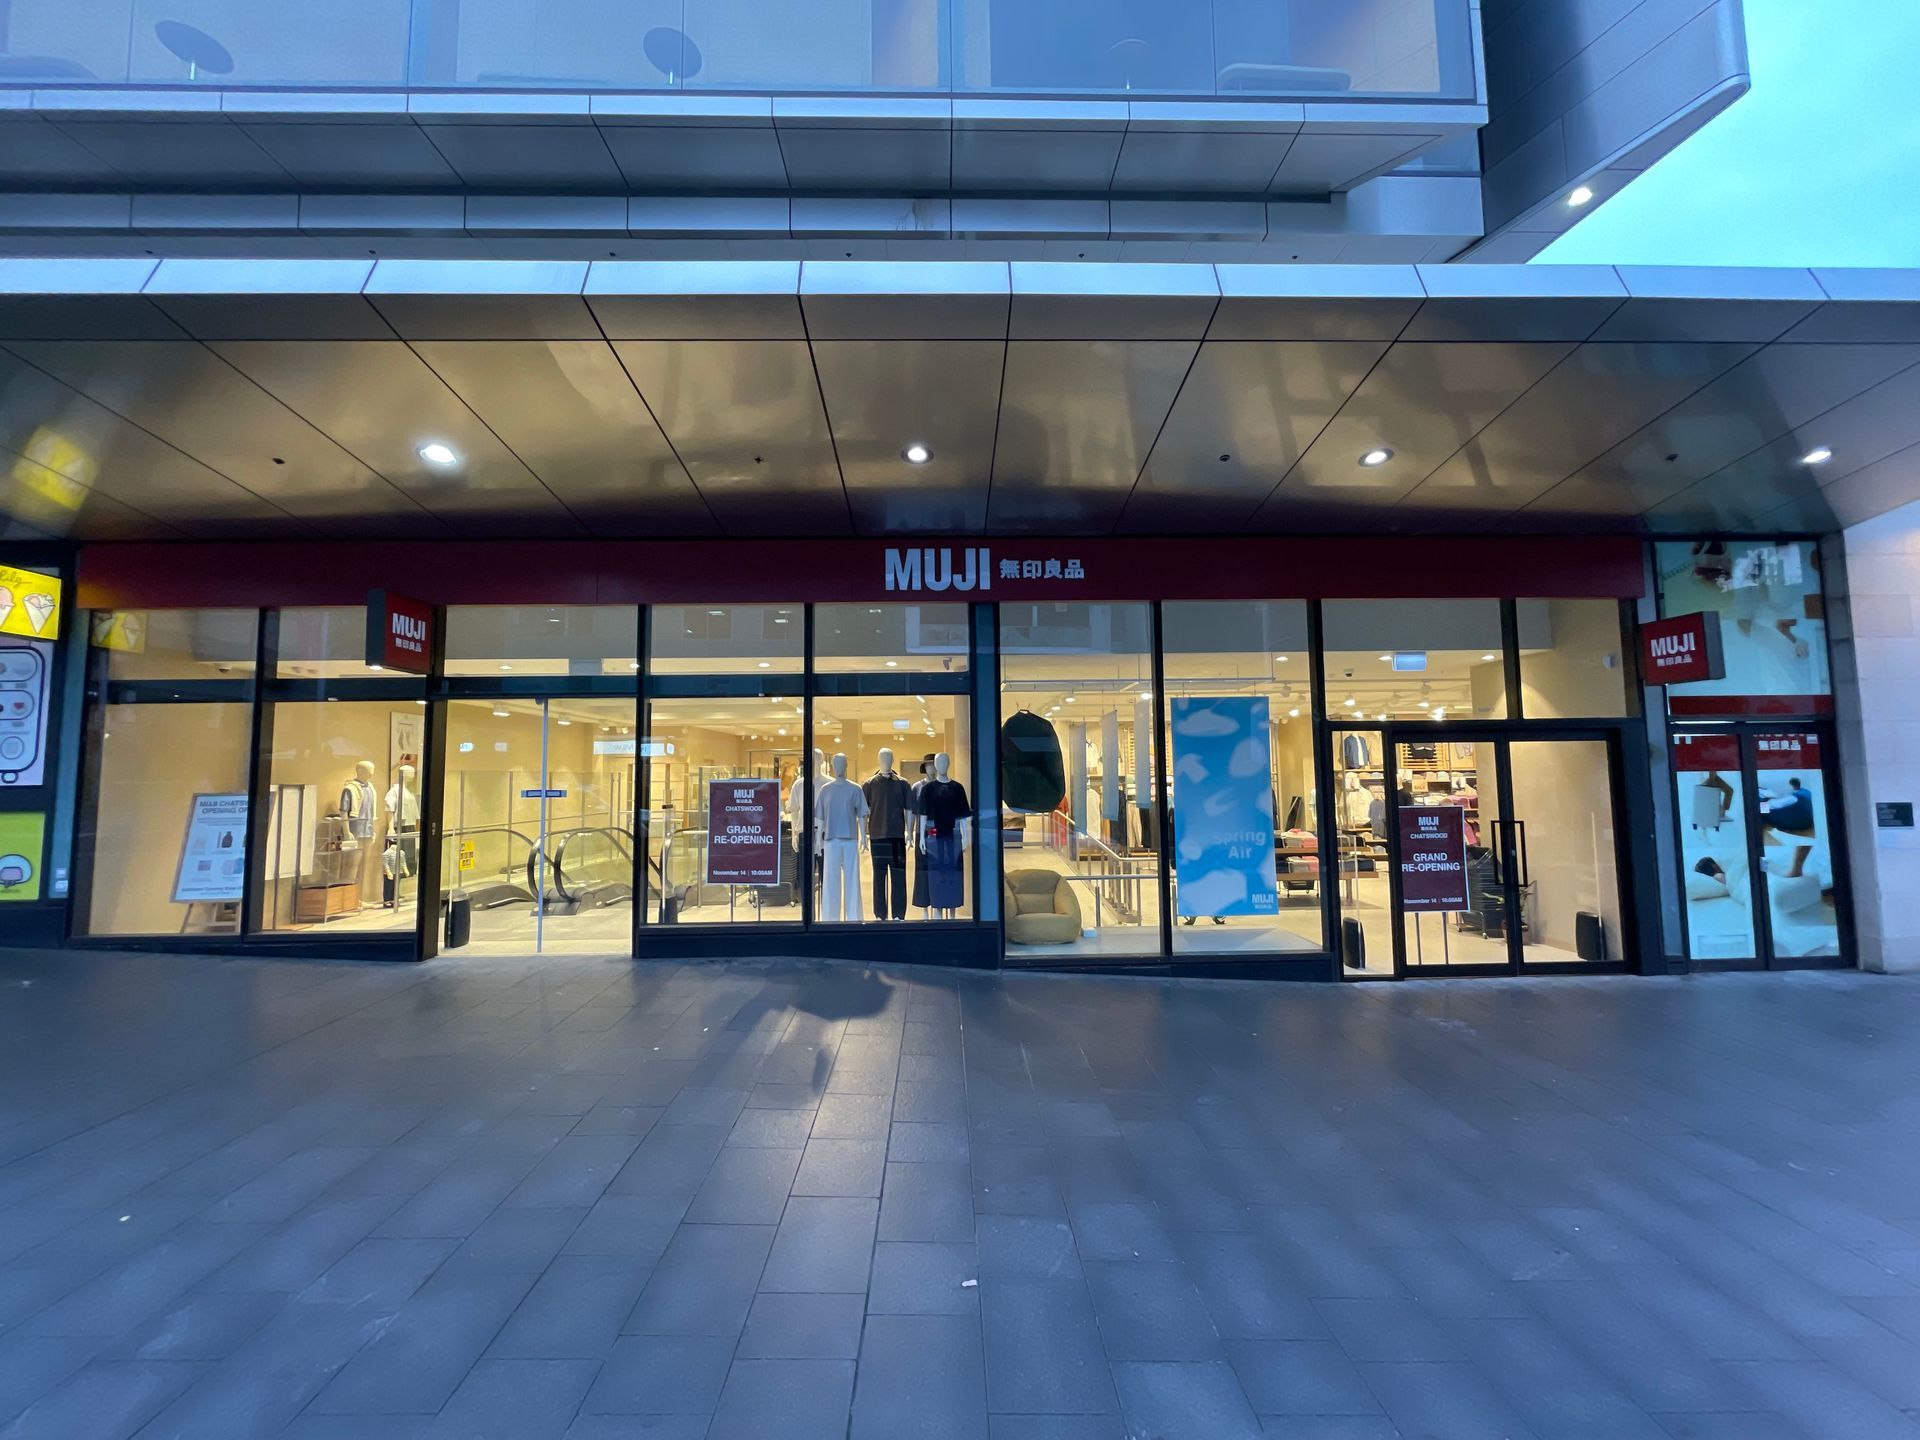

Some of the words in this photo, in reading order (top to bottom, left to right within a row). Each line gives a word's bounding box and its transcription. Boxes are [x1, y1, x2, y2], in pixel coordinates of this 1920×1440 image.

[885, 548, 991, 591] MUJI
[1000, 558, 1085, 579] 無印良品
[392, 612, 426, 641] MUJI
[1650, 632, 1696, 657] MUJI
[733, 789, 755, 799] MUJI
[1418, 816, 1440, 826] MUJI
[726, 825, 761, 834] GRAND
[714, 835, 774, 844] RE-OPENING
[1228, 846, 1253, 859] Air
[1413, 852, 1448, 862] GRAND
[1401, 862, 1461, 872] RE-OPENING
[1251, 894, 1274, 904] MUJI
